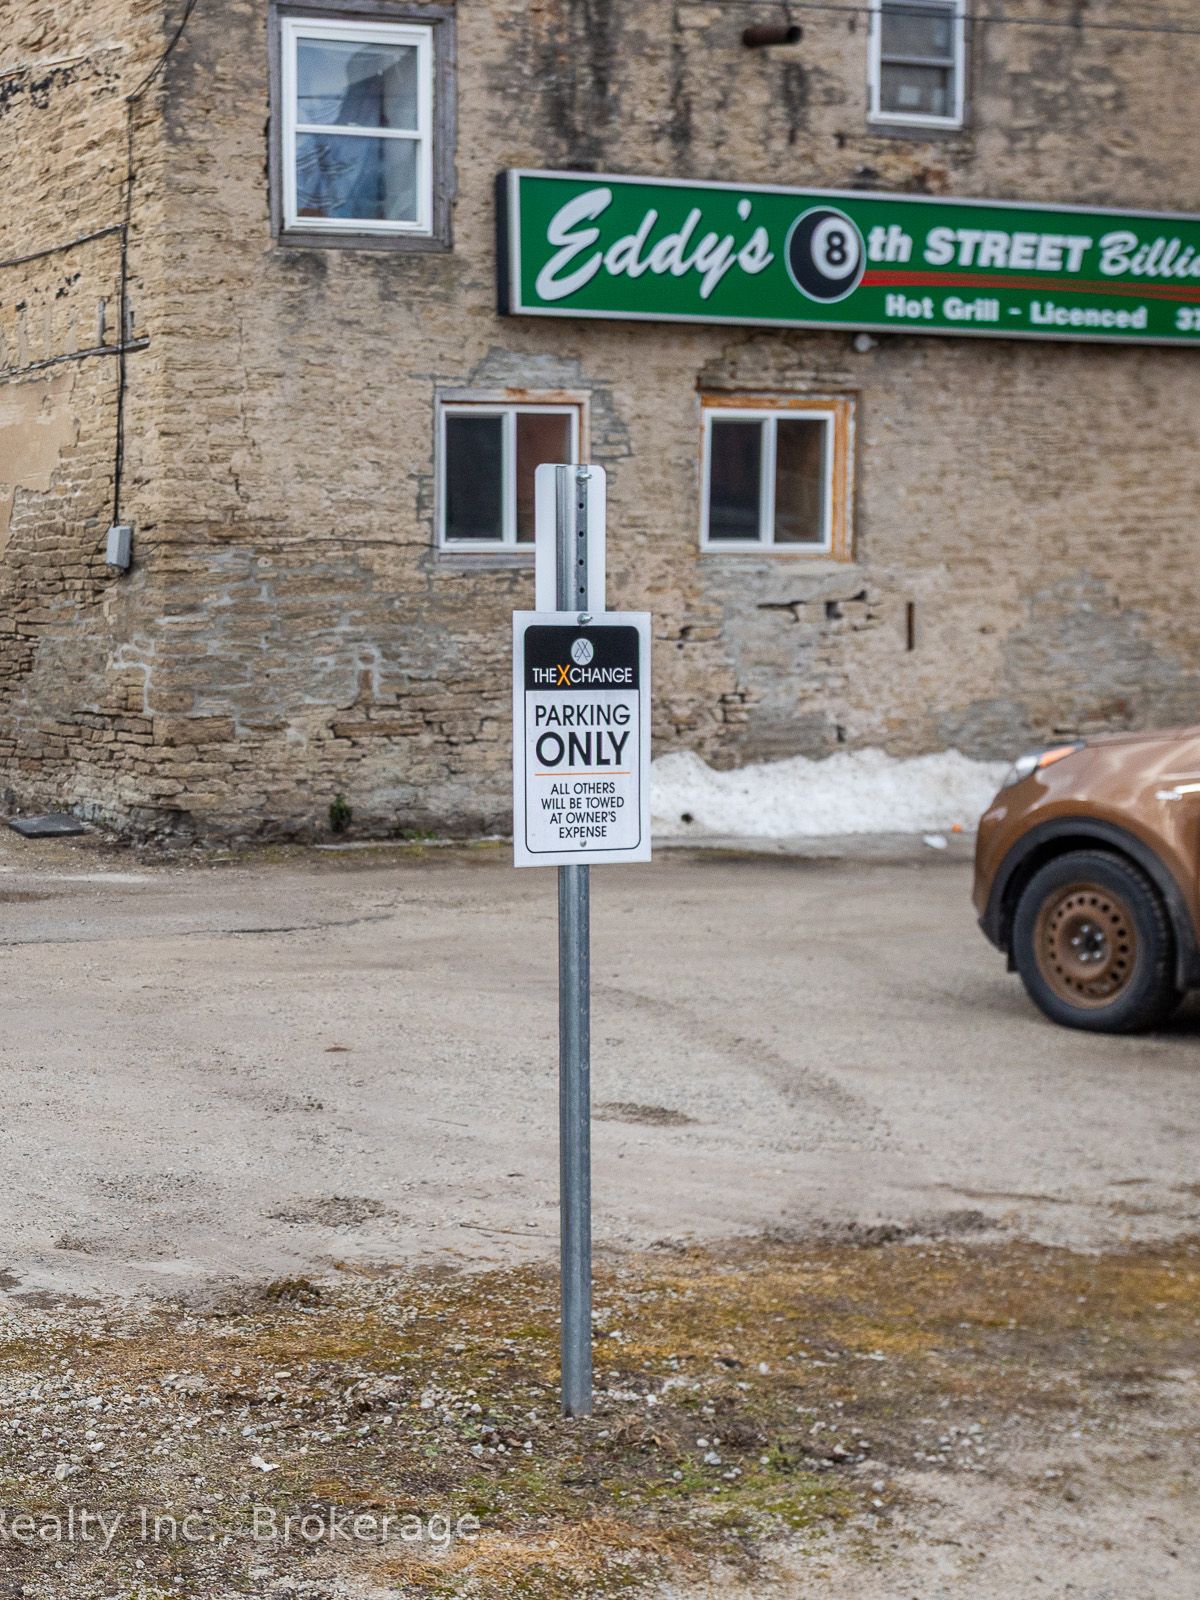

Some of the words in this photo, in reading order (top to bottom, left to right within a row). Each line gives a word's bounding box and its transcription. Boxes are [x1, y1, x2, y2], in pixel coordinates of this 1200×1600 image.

[534, 187, 774, 300] Eddy's
[826, 231, 847, 266] 8
[867, 225, 913, 264] th
[924, 226, 1093, 273] STREET
[885, 293, 934, 320] Hot
[943, 297, 1000, 322] Grill
[1029, 301, 1148, 330] Licenced
[535, 704, 631, 727] PARKING
[535, 730, 630, 767] ONLY
[550, 783, 570, 795] ALL
[573, 782, 615, 795] OTHERS
[541, 798, 566, 811] WILL
[569, 798, 583, 809] BE
[585, 796, 624, 809] TOWED
[550, 813, 564, 825] AT
[566, 811, 616, 824] OWNER'S
[559, 826, 607, 839] EXPENSE
